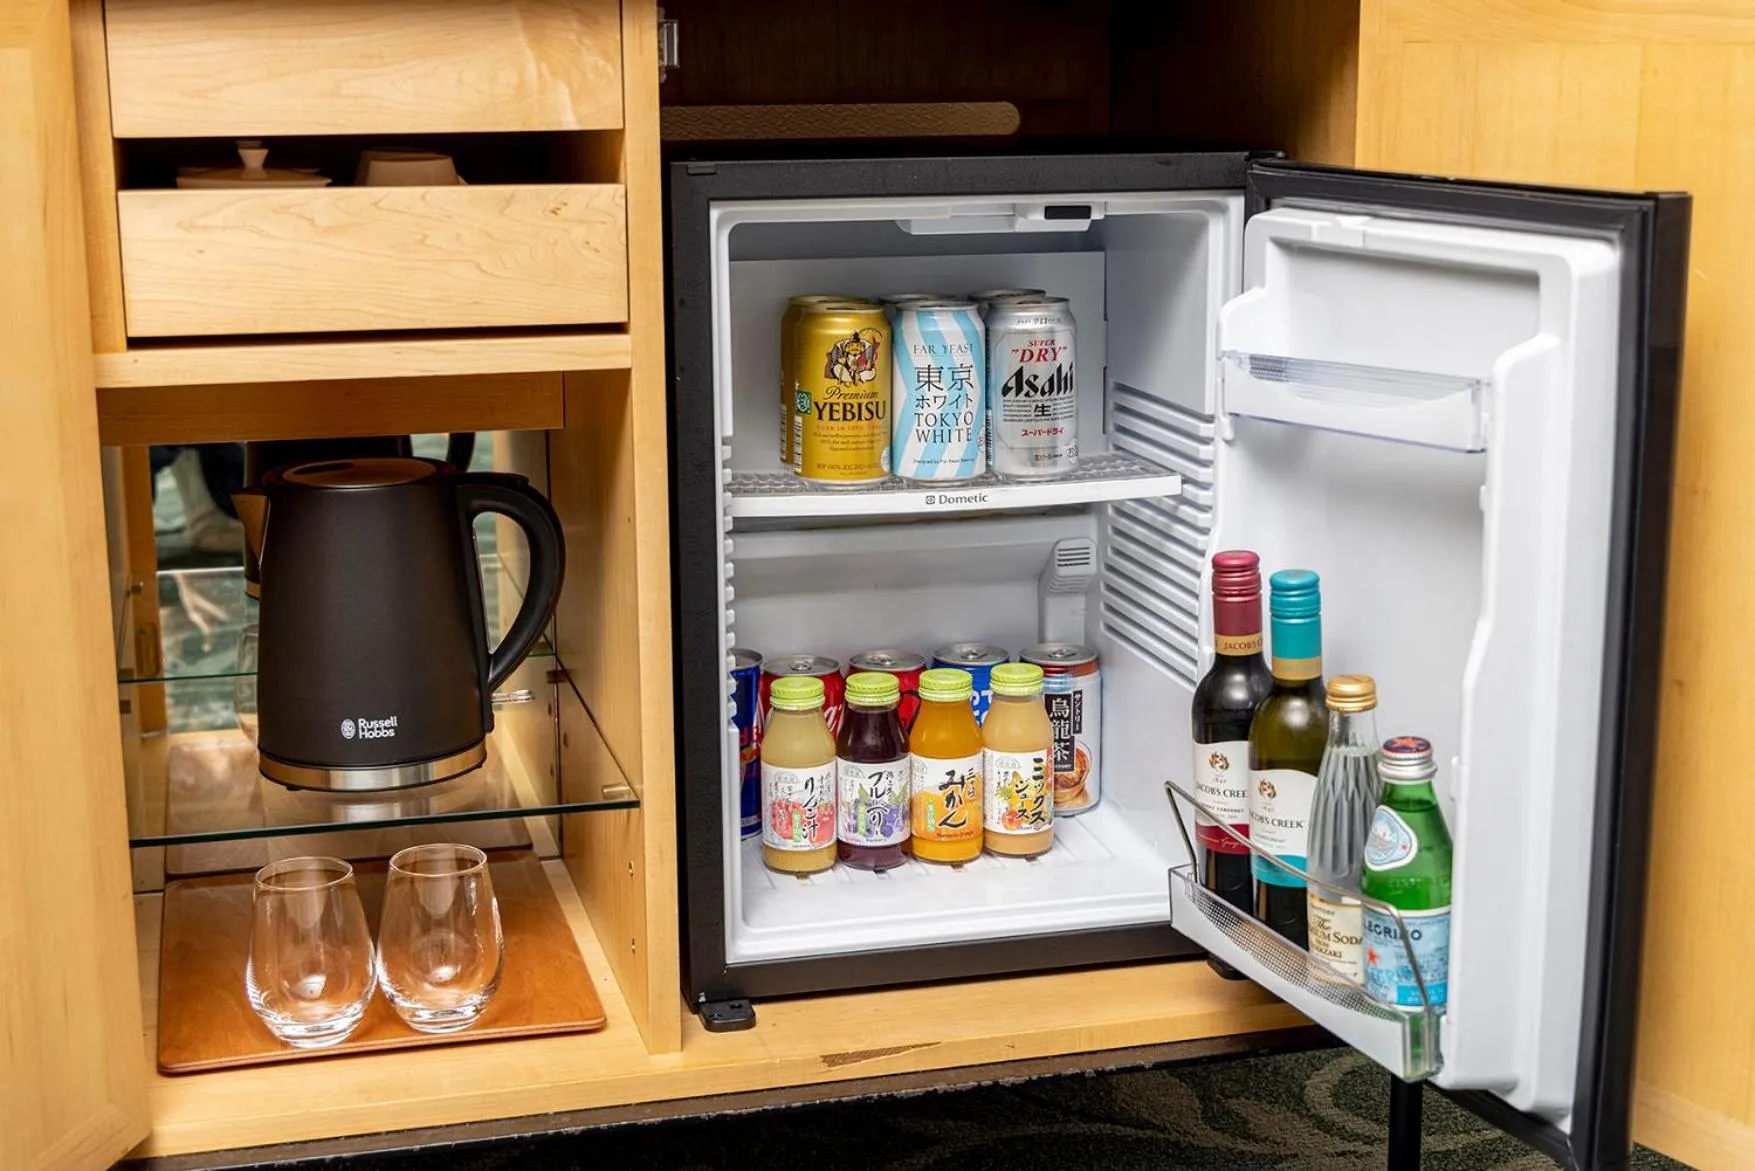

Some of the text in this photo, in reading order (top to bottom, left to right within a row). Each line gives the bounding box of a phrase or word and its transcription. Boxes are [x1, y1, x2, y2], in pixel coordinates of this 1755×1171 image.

[914, 344, 973, 354] FAR YEAST
[1028, 339, 1056, 347] SUPER
[914, 364, 974, 392] 東京
[1001, 362, 1074, 398] Asahi
[824, 385, 880, 400] Premium
[915, 393, 973, 409] ホワイト
[813, 401, 887, 421] YEBISU
[1034, 404, 1052, 417] 生
[914, 411, 974, 427] TOKYO
[916, 428, 972, 443] WHITE
[1022, 427, 1064, 437] スーパードライ
[939, 493, 989, 504] Dometic
[358, 715, 398, 729] Russell
[359, 727, 396, 739] Hobbs
[1050, 698, 1071, 761] 烏龍茶
[939, 769, 966, 829] みかん
[1223, 789, 1249, 798] CREE
[1271, 818, 1304, 829] CREEK
